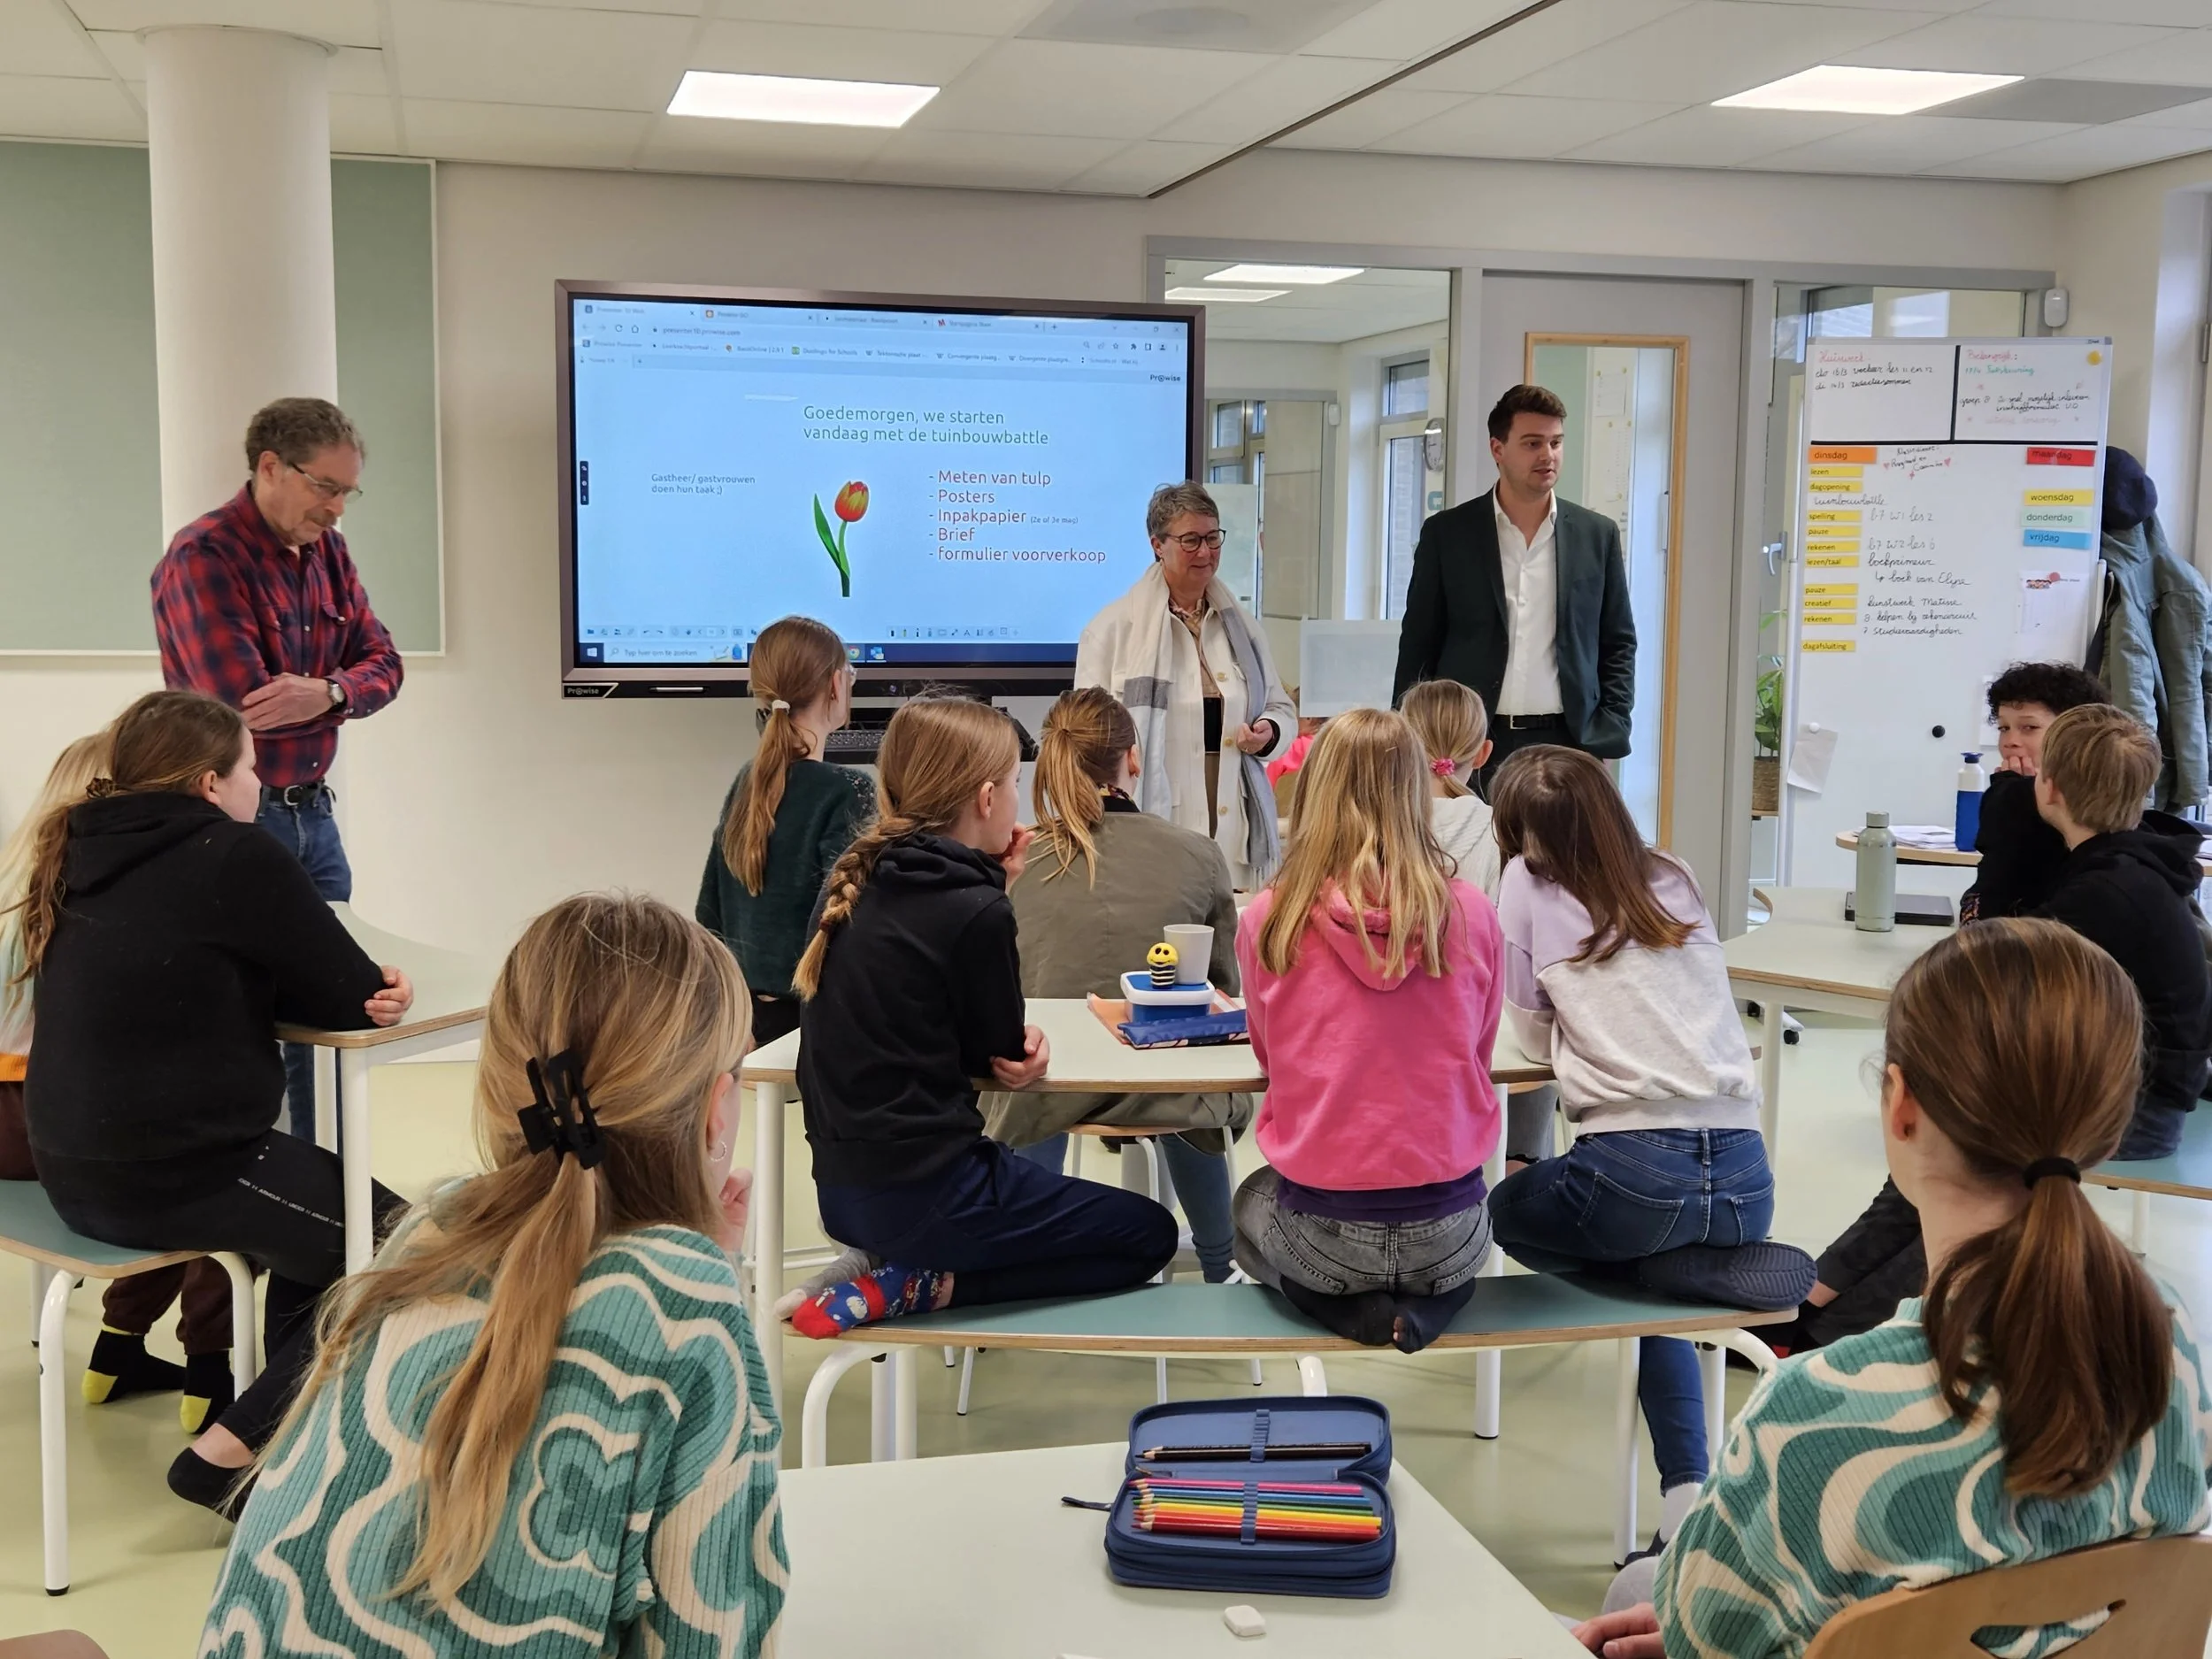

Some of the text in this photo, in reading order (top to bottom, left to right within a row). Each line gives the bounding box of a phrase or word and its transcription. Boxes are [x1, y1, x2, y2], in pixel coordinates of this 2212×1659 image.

[803, 405, 1005, 425] Goedemorgen, we starten
[803, 425, 1049, 444] vandaag met de tuinbouwbattle
[1814, 450, 1848, 461] dinsdag
[2032, 449, 2073, 461] maandag
[651, 473, 756, 486] Gastheer/ gastvrouwen
[938, 471, 987, 484] Meten
[991, 473, 1018, 485] van
[1021, 471, 1051, 488] tulp
[651, 485, 675, 494] doen
[676, 485, 694, 494] hun
[1809, 482, 1851, 492] dagopening
[938, 489, 995, 503] Posters
[2031, 493, 2074, 503] woensdag
[938, 509, 1027, 525] Inpakpapier
[1808, 511, 1836, 521] spelling
[2026, 513, 2073, 523] donderdag
[938, 526, 975, 541] Brief
[2030, 533, 2060, 543] vrijdag
[938, 546, 1009, 561] formulier
[1011, 548, 1107, 565] voorverkoop
[1806, 557, 1841, 567] lezen/taal
[1802, 641, 1847, 652] dagafsluiting
[624, 649, 636, 657] Typ
[673, 649, 698, 657] zoeken
[567, 687, 600, 695] Prowise
